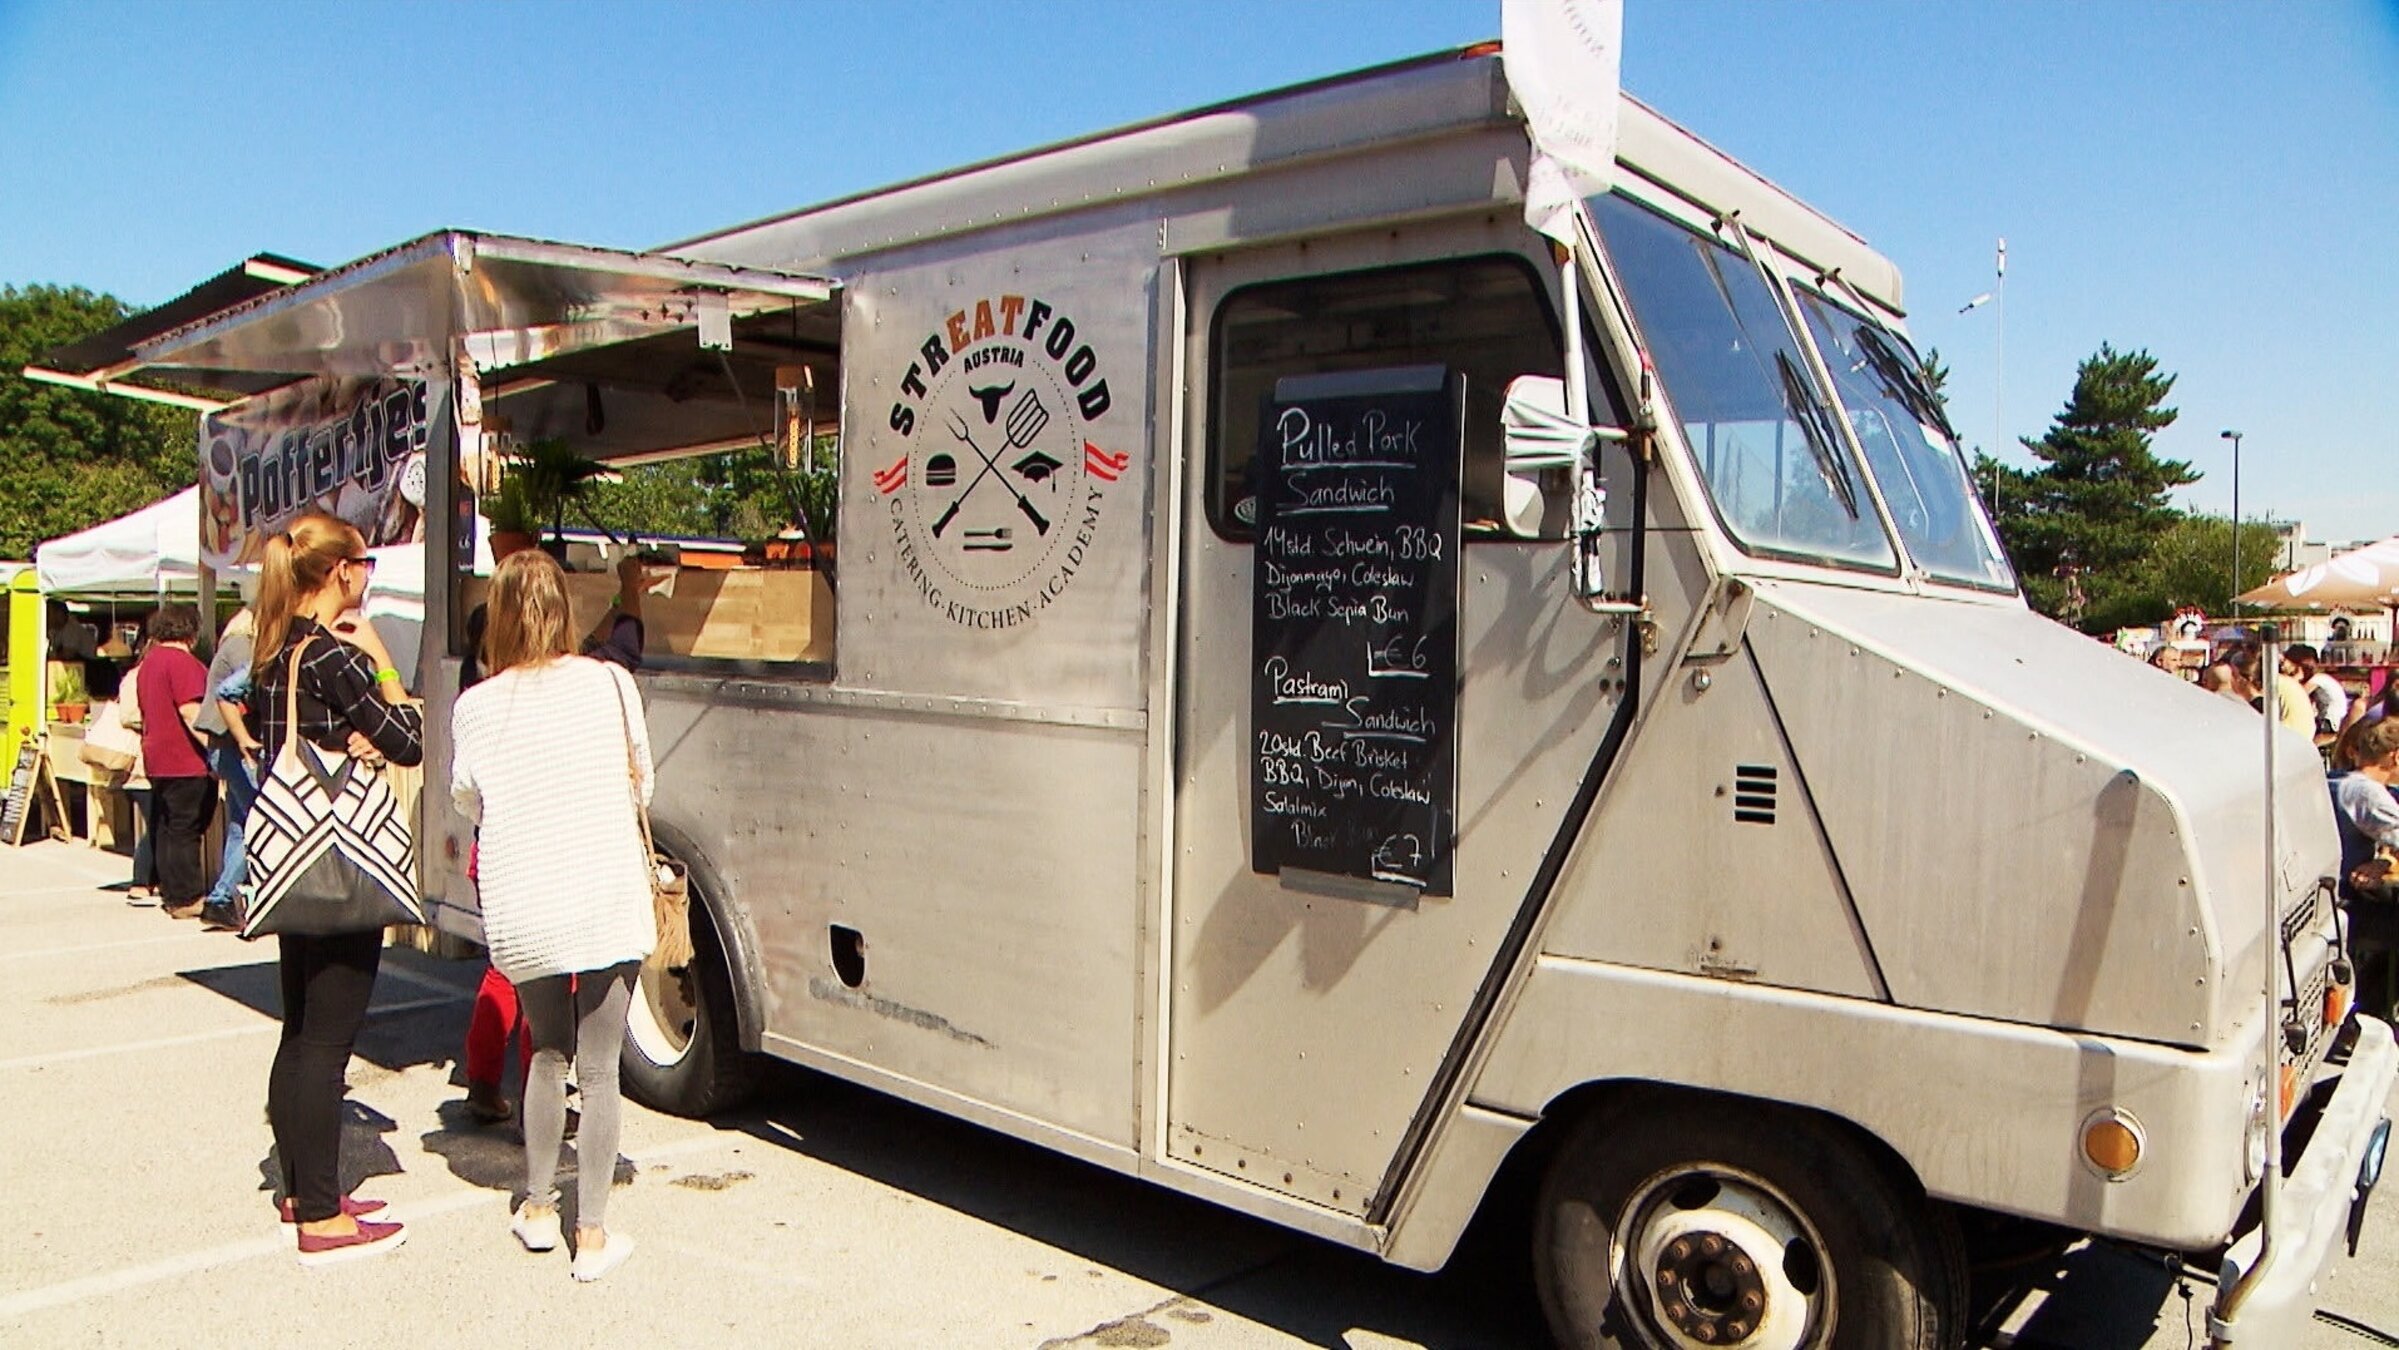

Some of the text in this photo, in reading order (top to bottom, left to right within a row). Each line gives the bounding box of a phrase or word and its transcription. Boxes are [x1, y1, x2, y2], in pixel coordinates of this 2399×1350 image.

[890, 295, 1111, 437] STREATFOOD
[963, 346, 1025, 374] AUSTRIA
[1277, 407, 1423, 464] Pulled Pork
[1287, 472, 1395, 506] Sandwich
[1395, 525, 1442, 561] BBQ
[1264, 592, 1320, 620] Black
[1370, 595, 1409, 624] Bun
[1264, 655, 1350, 699] Pastrami
[1345, 695, 1436, 735] Sandwich
[1304, 730, 1349, 763] Beef
